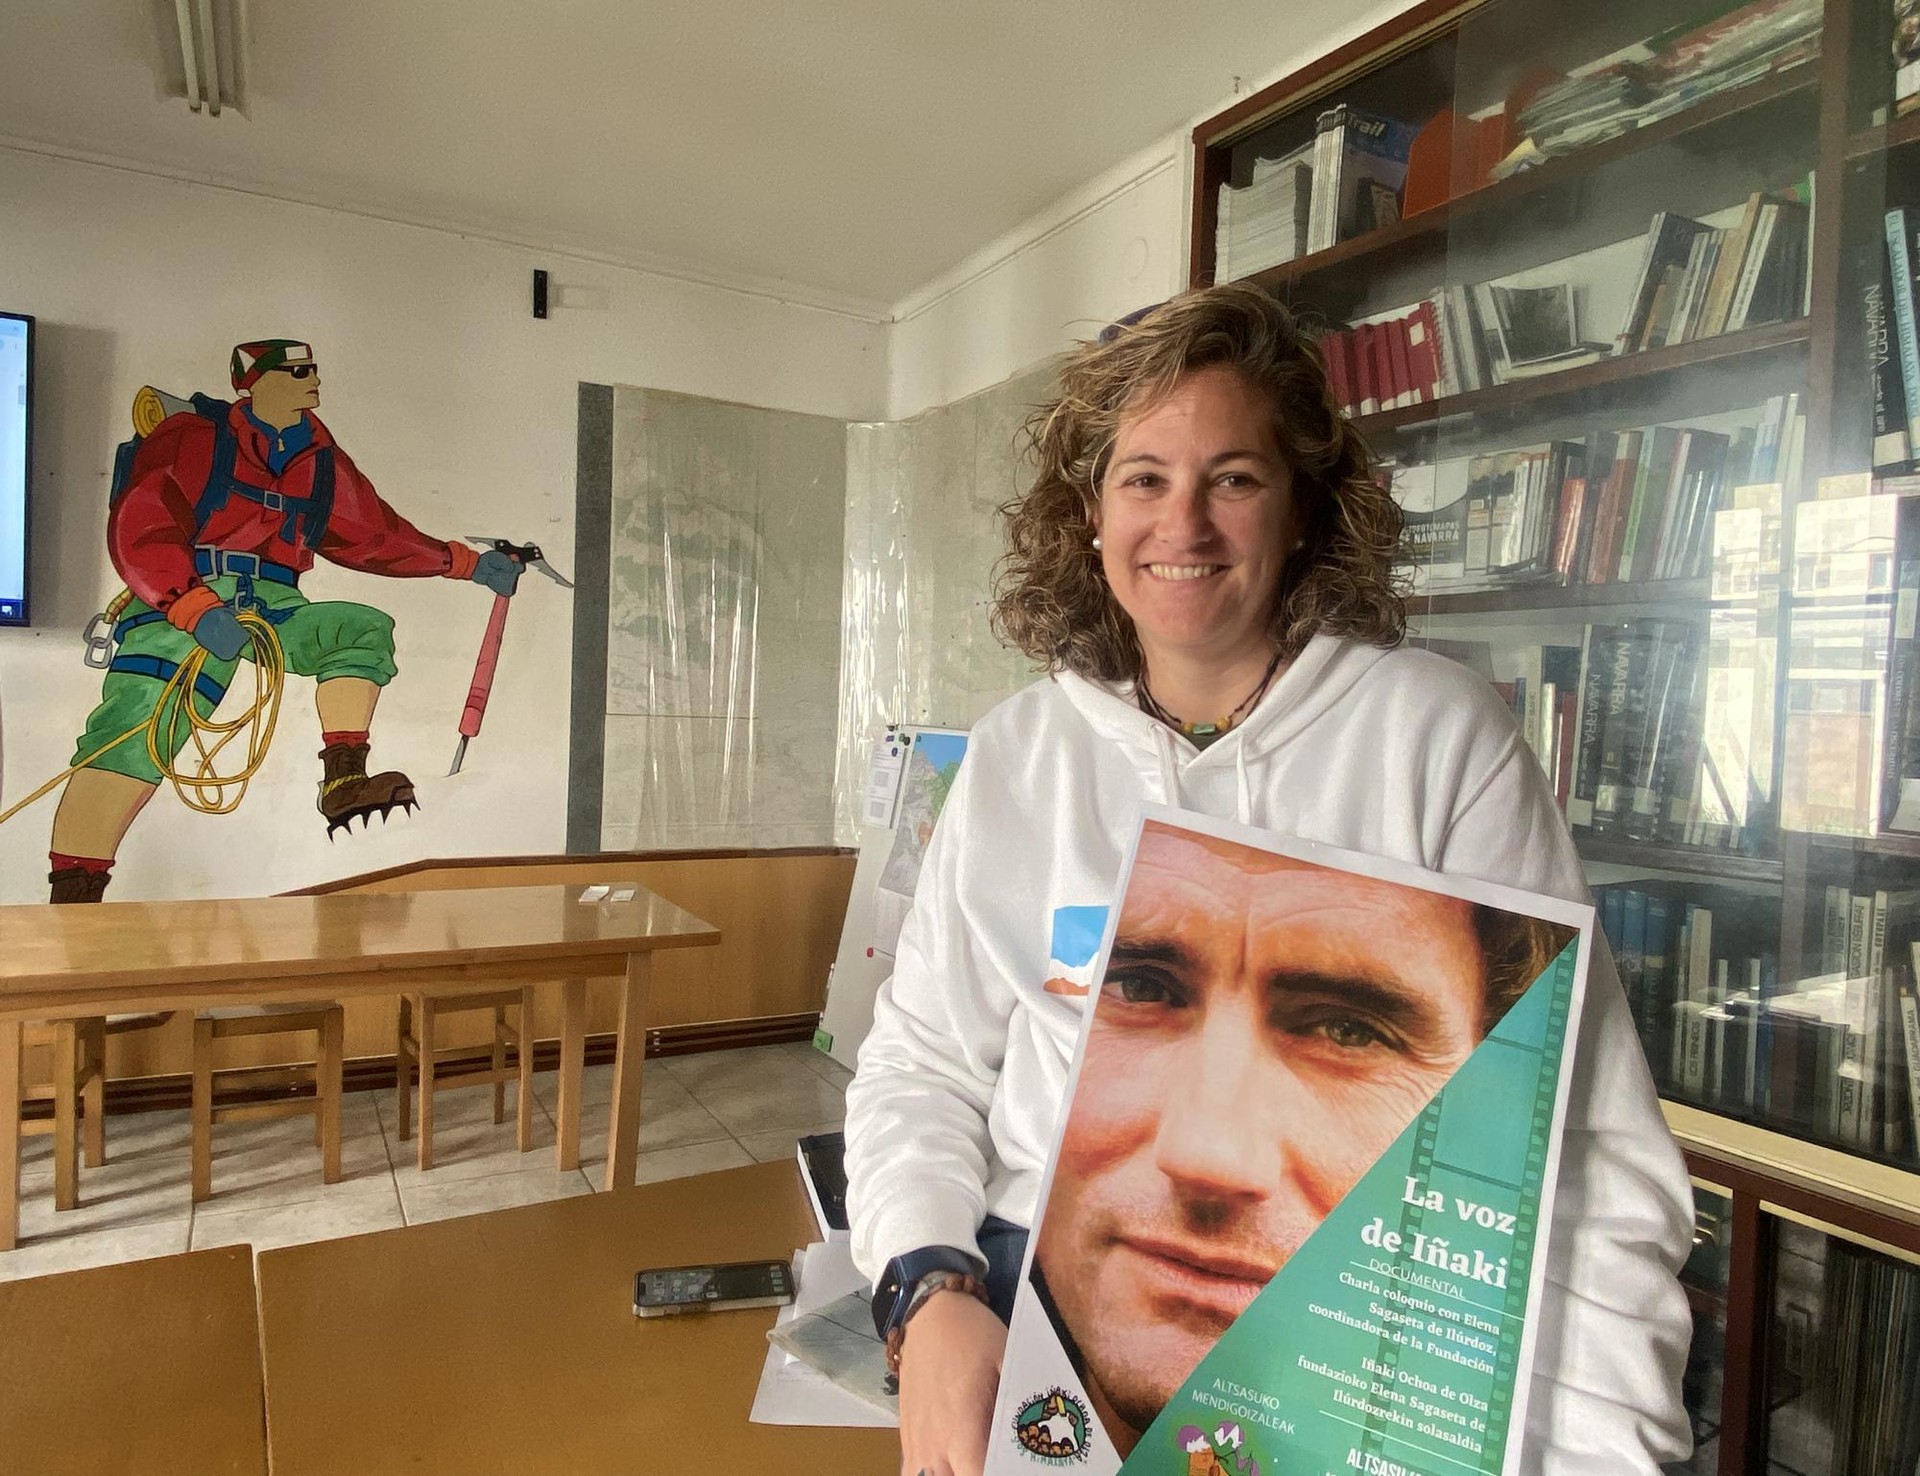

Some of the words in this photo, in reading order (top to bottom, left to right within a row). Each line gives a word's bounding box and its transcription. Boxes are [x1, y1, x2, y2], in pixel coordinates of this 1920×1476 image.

[1414, 530, 1460, 544] NAVARRA
[1583, 673, 1602, 744] NAVARRA
[1609, 641, 1631, 716] NAVARRA
[1401, 1175, 1445, 1214] La
[1455, 1197, 1517, 1235] voz
[1361, 1217, 1402, 1254] de
[1410, 1233, 1508, 1289] Iñaki
[1369, 1258, 1467, 1299] DOCUMENTAL
[1339, 1271, 1380, 1296] Charla
[1383, 1286, 1435, 1314] coloquio
[1438, 1305, 1461, 1322] con
[1464, 1312, 1501, 1336] Elena
[1368, 1302, 1424, 1331] Sagaseta
[1427, 1317, 1444, 1336] de
[1446, 1322, 1497, 1356] Ilúrdoz,
[1308, 1301, 1390, 1340] coordinadora
[1392, 1327, 1409, 1345] de
[1411, 1334, 1424, 1351] la
[1426, 1341, 1495, 1376] Fundación
[1191, 1390, 1297, 1436] MENDIGOIZALEAK
[1212, 1378, 1281, 1411] ALTSASUKO
[1297, 1355, 1368, 1391] fundazioko
[1370, 1381, 1407, 1405] Elena
[1409, 1396, 1467, 1427] Sagaseta
[1469, 1413, 1486, 1433] de
[1361, 1356, 1396, 1379] Iñaki
[1398, 1369, 1438, 1396] Ochoa
[1440, 1382, 1457, 1401] de
[1459, 1390, 1489, 1413] Olza
[1333, 1389, 1414, 1429] Ilúrdozrekin
[1416, 1421, 1483, 1455] solasaldia
